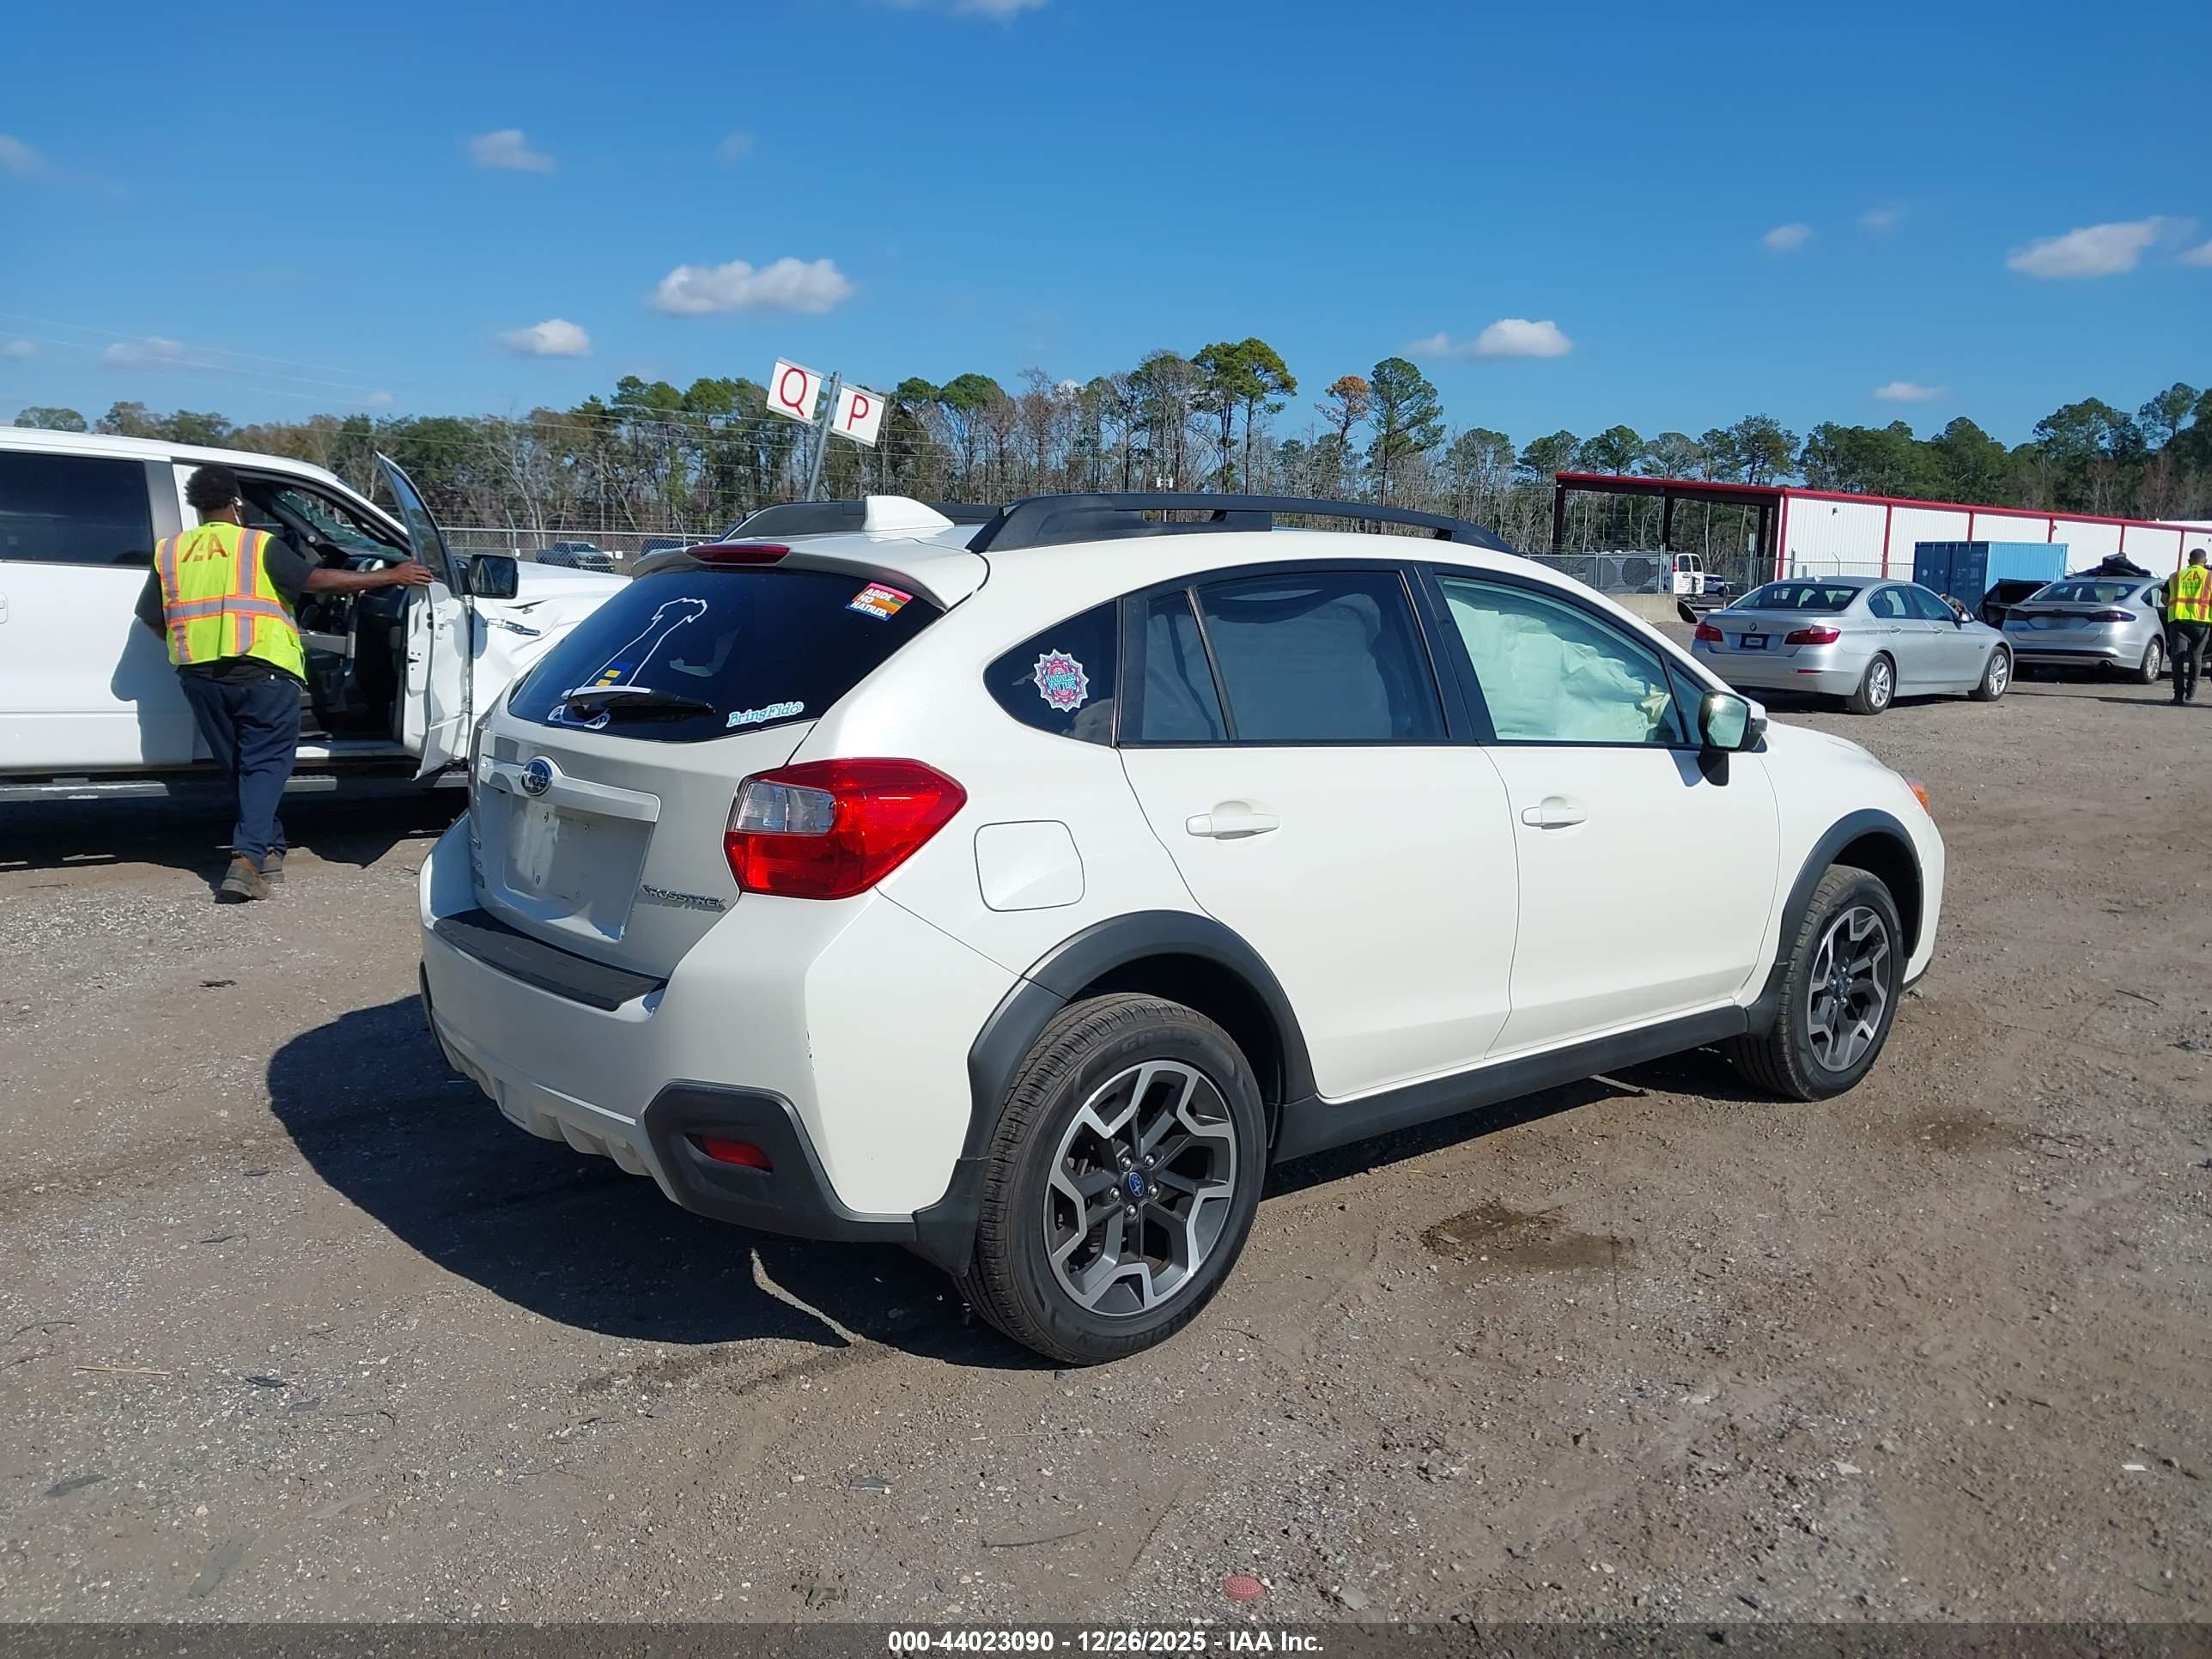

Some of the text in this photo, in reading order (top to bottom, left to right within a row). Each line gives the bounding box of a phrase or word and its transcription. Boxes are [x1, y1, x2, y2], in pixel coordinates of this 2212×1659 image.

[781, 368, 807, 417] Q
[847, 394, 869, 431] P
[857, 594, 873, 604] NO
[1046, 672, 1076, 683] KINDNESS
[1048, 681, 1077, 690] MATTERS
[728, 702, 800, 726] BringFido
